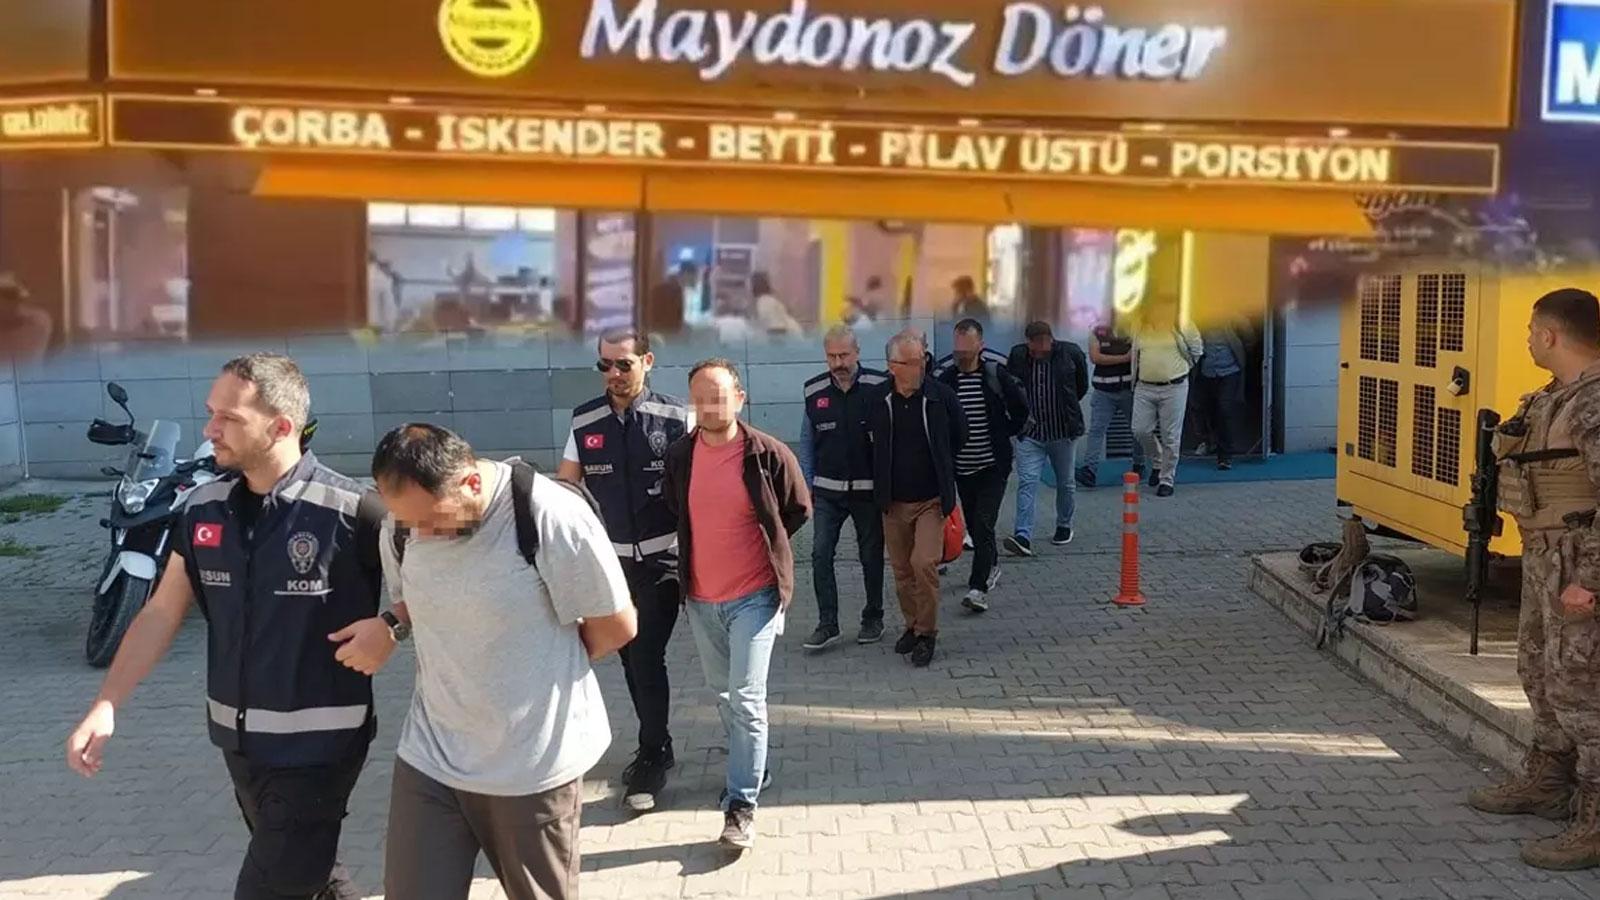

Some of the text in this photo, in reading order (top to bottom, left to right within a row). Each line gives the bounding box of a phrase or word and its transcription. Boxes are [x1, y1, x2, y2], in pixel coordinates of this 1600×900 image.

[579, 0, 1227, 87] Maydonoz Döner
[232, 106, 391, 149] ÇORBA
[709, 121, 835, 163] BEYTİ
[880, 125, 1006, 170] PİLAV
[1019, 130, 1128, 175] ÜSTÜ
[286, 579, 322, 591] KOM
